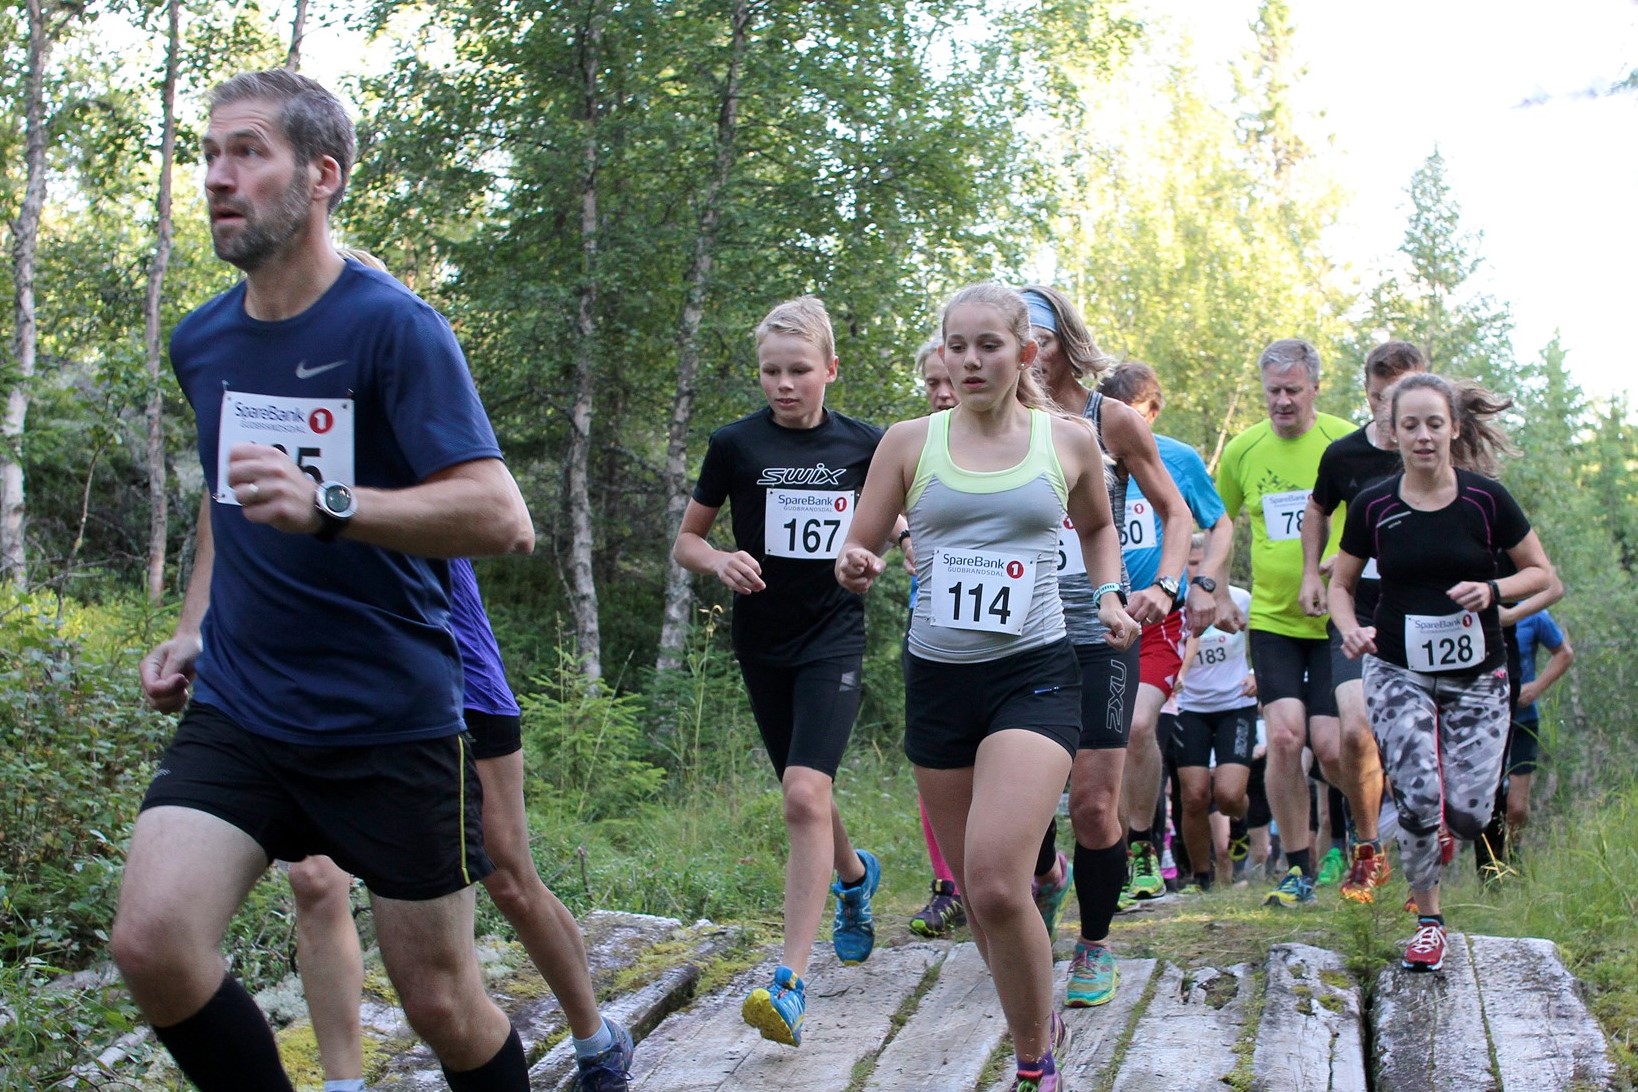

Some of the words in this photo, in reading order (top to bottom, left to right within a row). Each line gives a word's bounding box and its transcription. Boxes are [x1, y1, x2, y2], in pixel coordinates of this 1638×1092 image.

[234, 401, 306, 424] SpareBank
[778, 494, 833, 506] SpareBank
[783, 518, 841, 553] 167
[943, 553, 1005, 570] SpareBank
[947, 566, 1005, 577] GUDBRANDSDAL
[948, 581, 1011, 625] 114
[1415, 619, 1461, 630] SpareBank
[1196, 647, 1227, 665] 183
[1421, 634, 1473, 666] 128
[1106, 658, 1128, 734] 2XU
